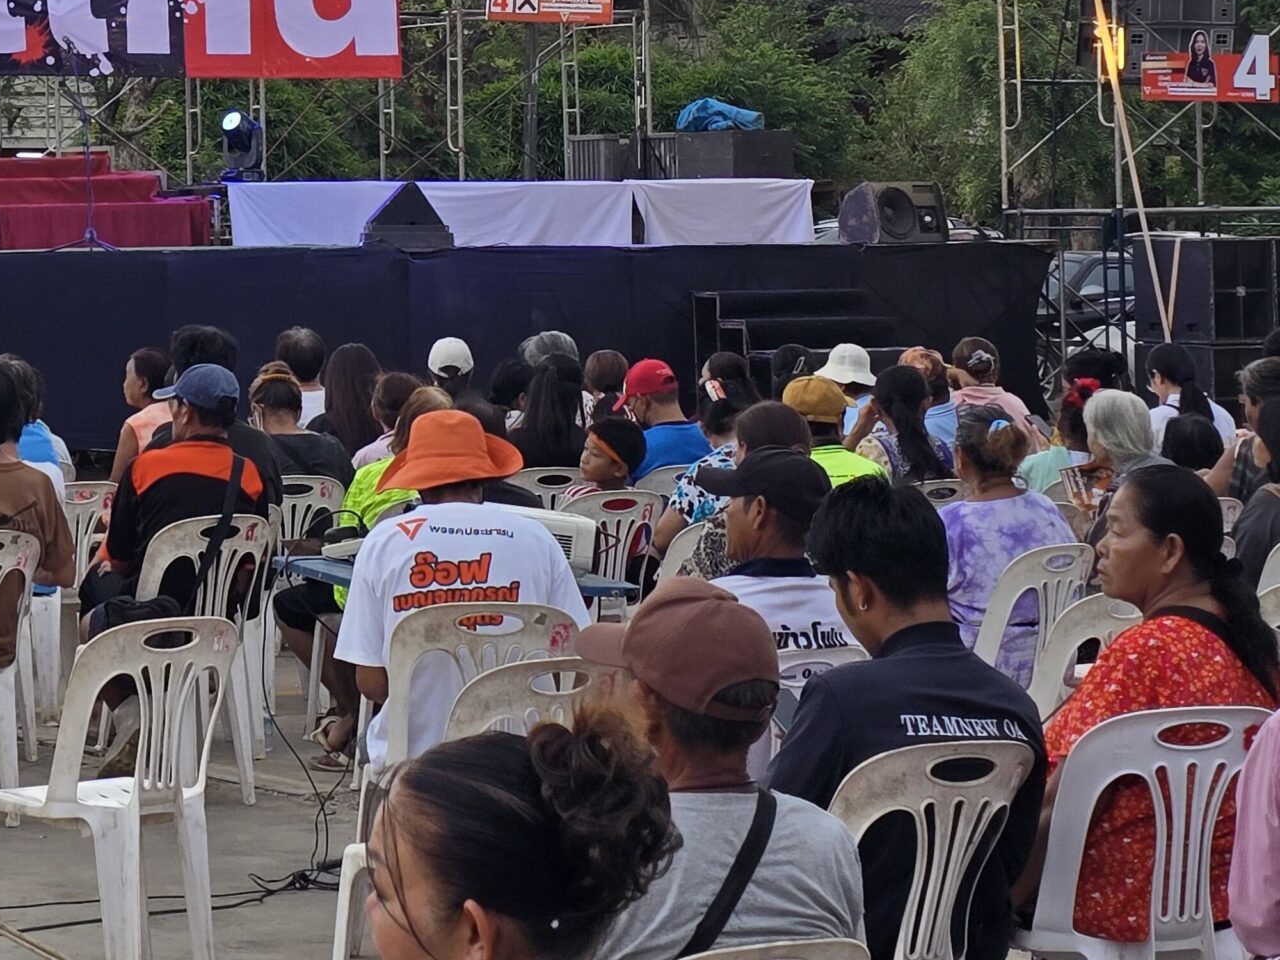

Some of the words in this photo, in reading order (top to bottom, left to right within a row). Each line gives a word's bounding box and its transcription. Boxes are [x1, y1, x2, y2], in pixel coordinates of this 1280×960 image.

[1233, 34, 1275, 100] 4
[410, 551, 492, 588] อ๊อฟ
[900, 714, 1000, 737] TEAMNEW
